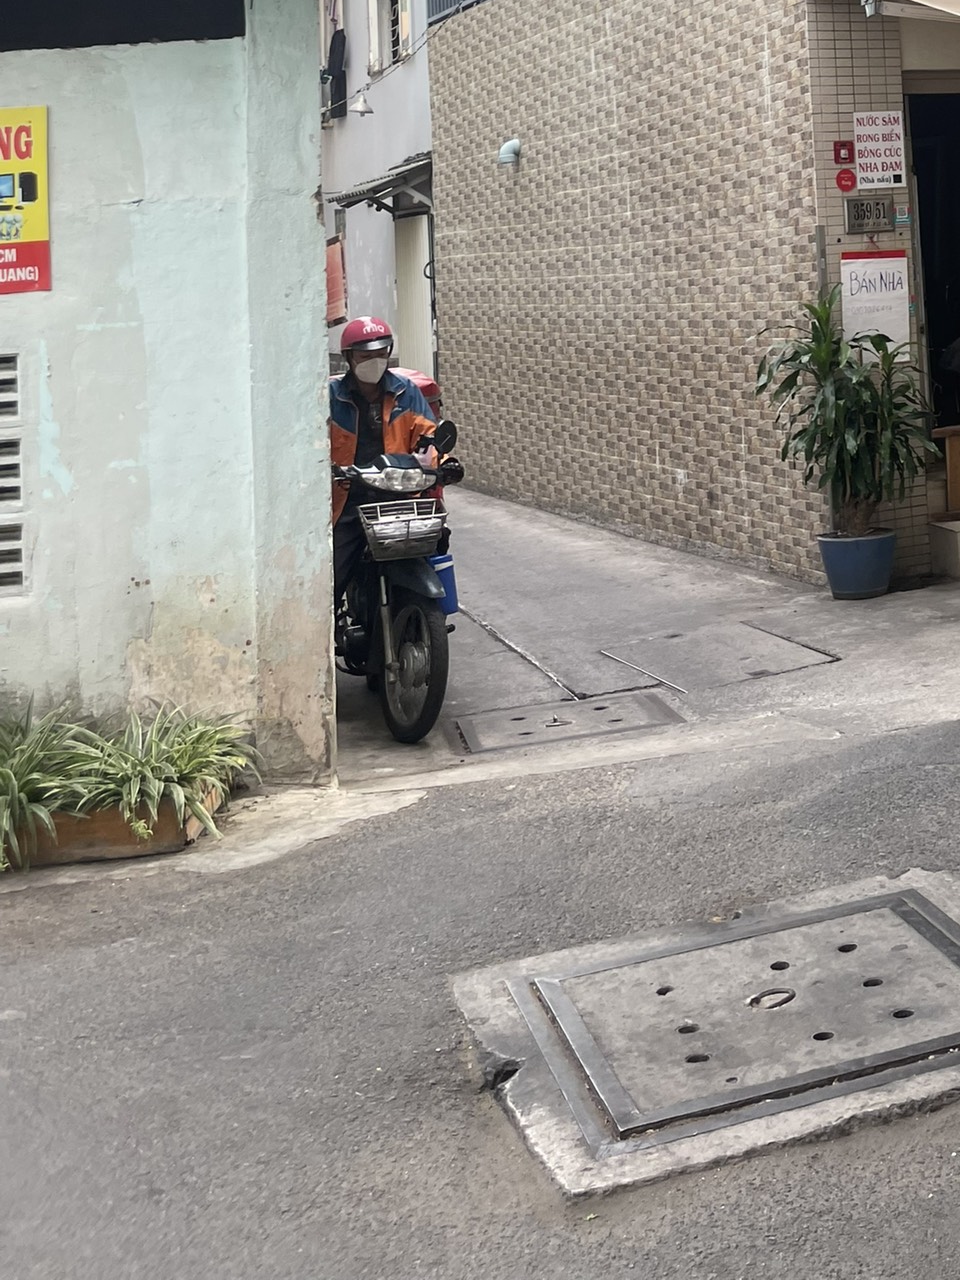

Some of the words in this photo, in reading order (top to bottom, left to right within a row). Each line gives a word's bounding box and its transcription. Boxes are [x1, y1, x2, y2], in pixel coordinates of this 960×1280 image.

[856, 114, 880, 127] NƯỚC
[881, 113, 900, 126] SÂM
[856, 133, 880, 143] RONG
[881, 128, 901, 142] BIỂN
[858, 146, 882, 159] BÔNG
[884, 145, 902, 157] CÚC
[858, 162, 879, 173] NHA
[881, 161, 902, 172] ĐAM
[853, 202, 887, 221] 359/51
[850, 270, 877, 296] BÁN
[880, 270, 904, 292] NHÀ
